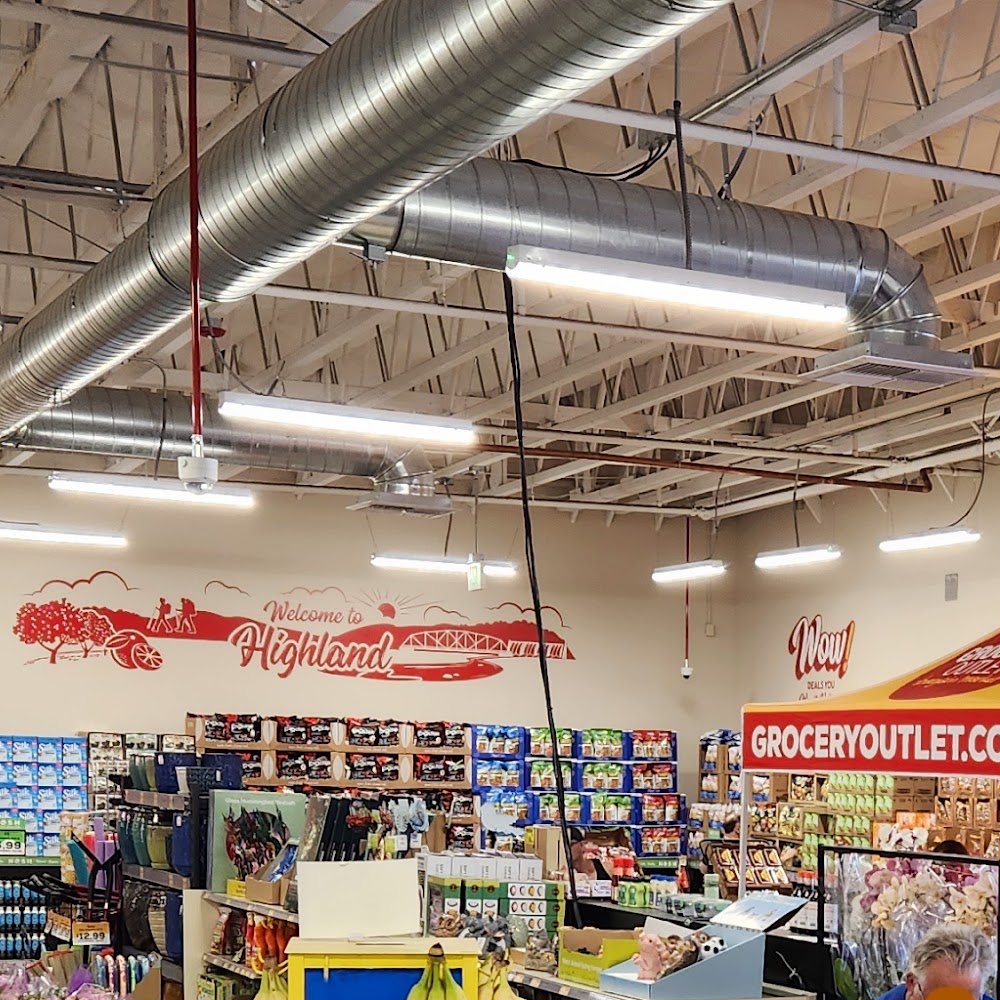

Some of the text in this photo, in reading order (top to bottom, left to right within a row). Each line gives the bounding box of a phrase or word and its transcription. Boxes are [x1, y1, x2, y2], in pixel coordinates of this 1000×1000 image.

[263, 600, 363, 625] Welcome to
[229, 623, 394, 679] Highland
[788, 614, 856, 680] Wow!
[807, 681, 835, 690] DEALS YOU
